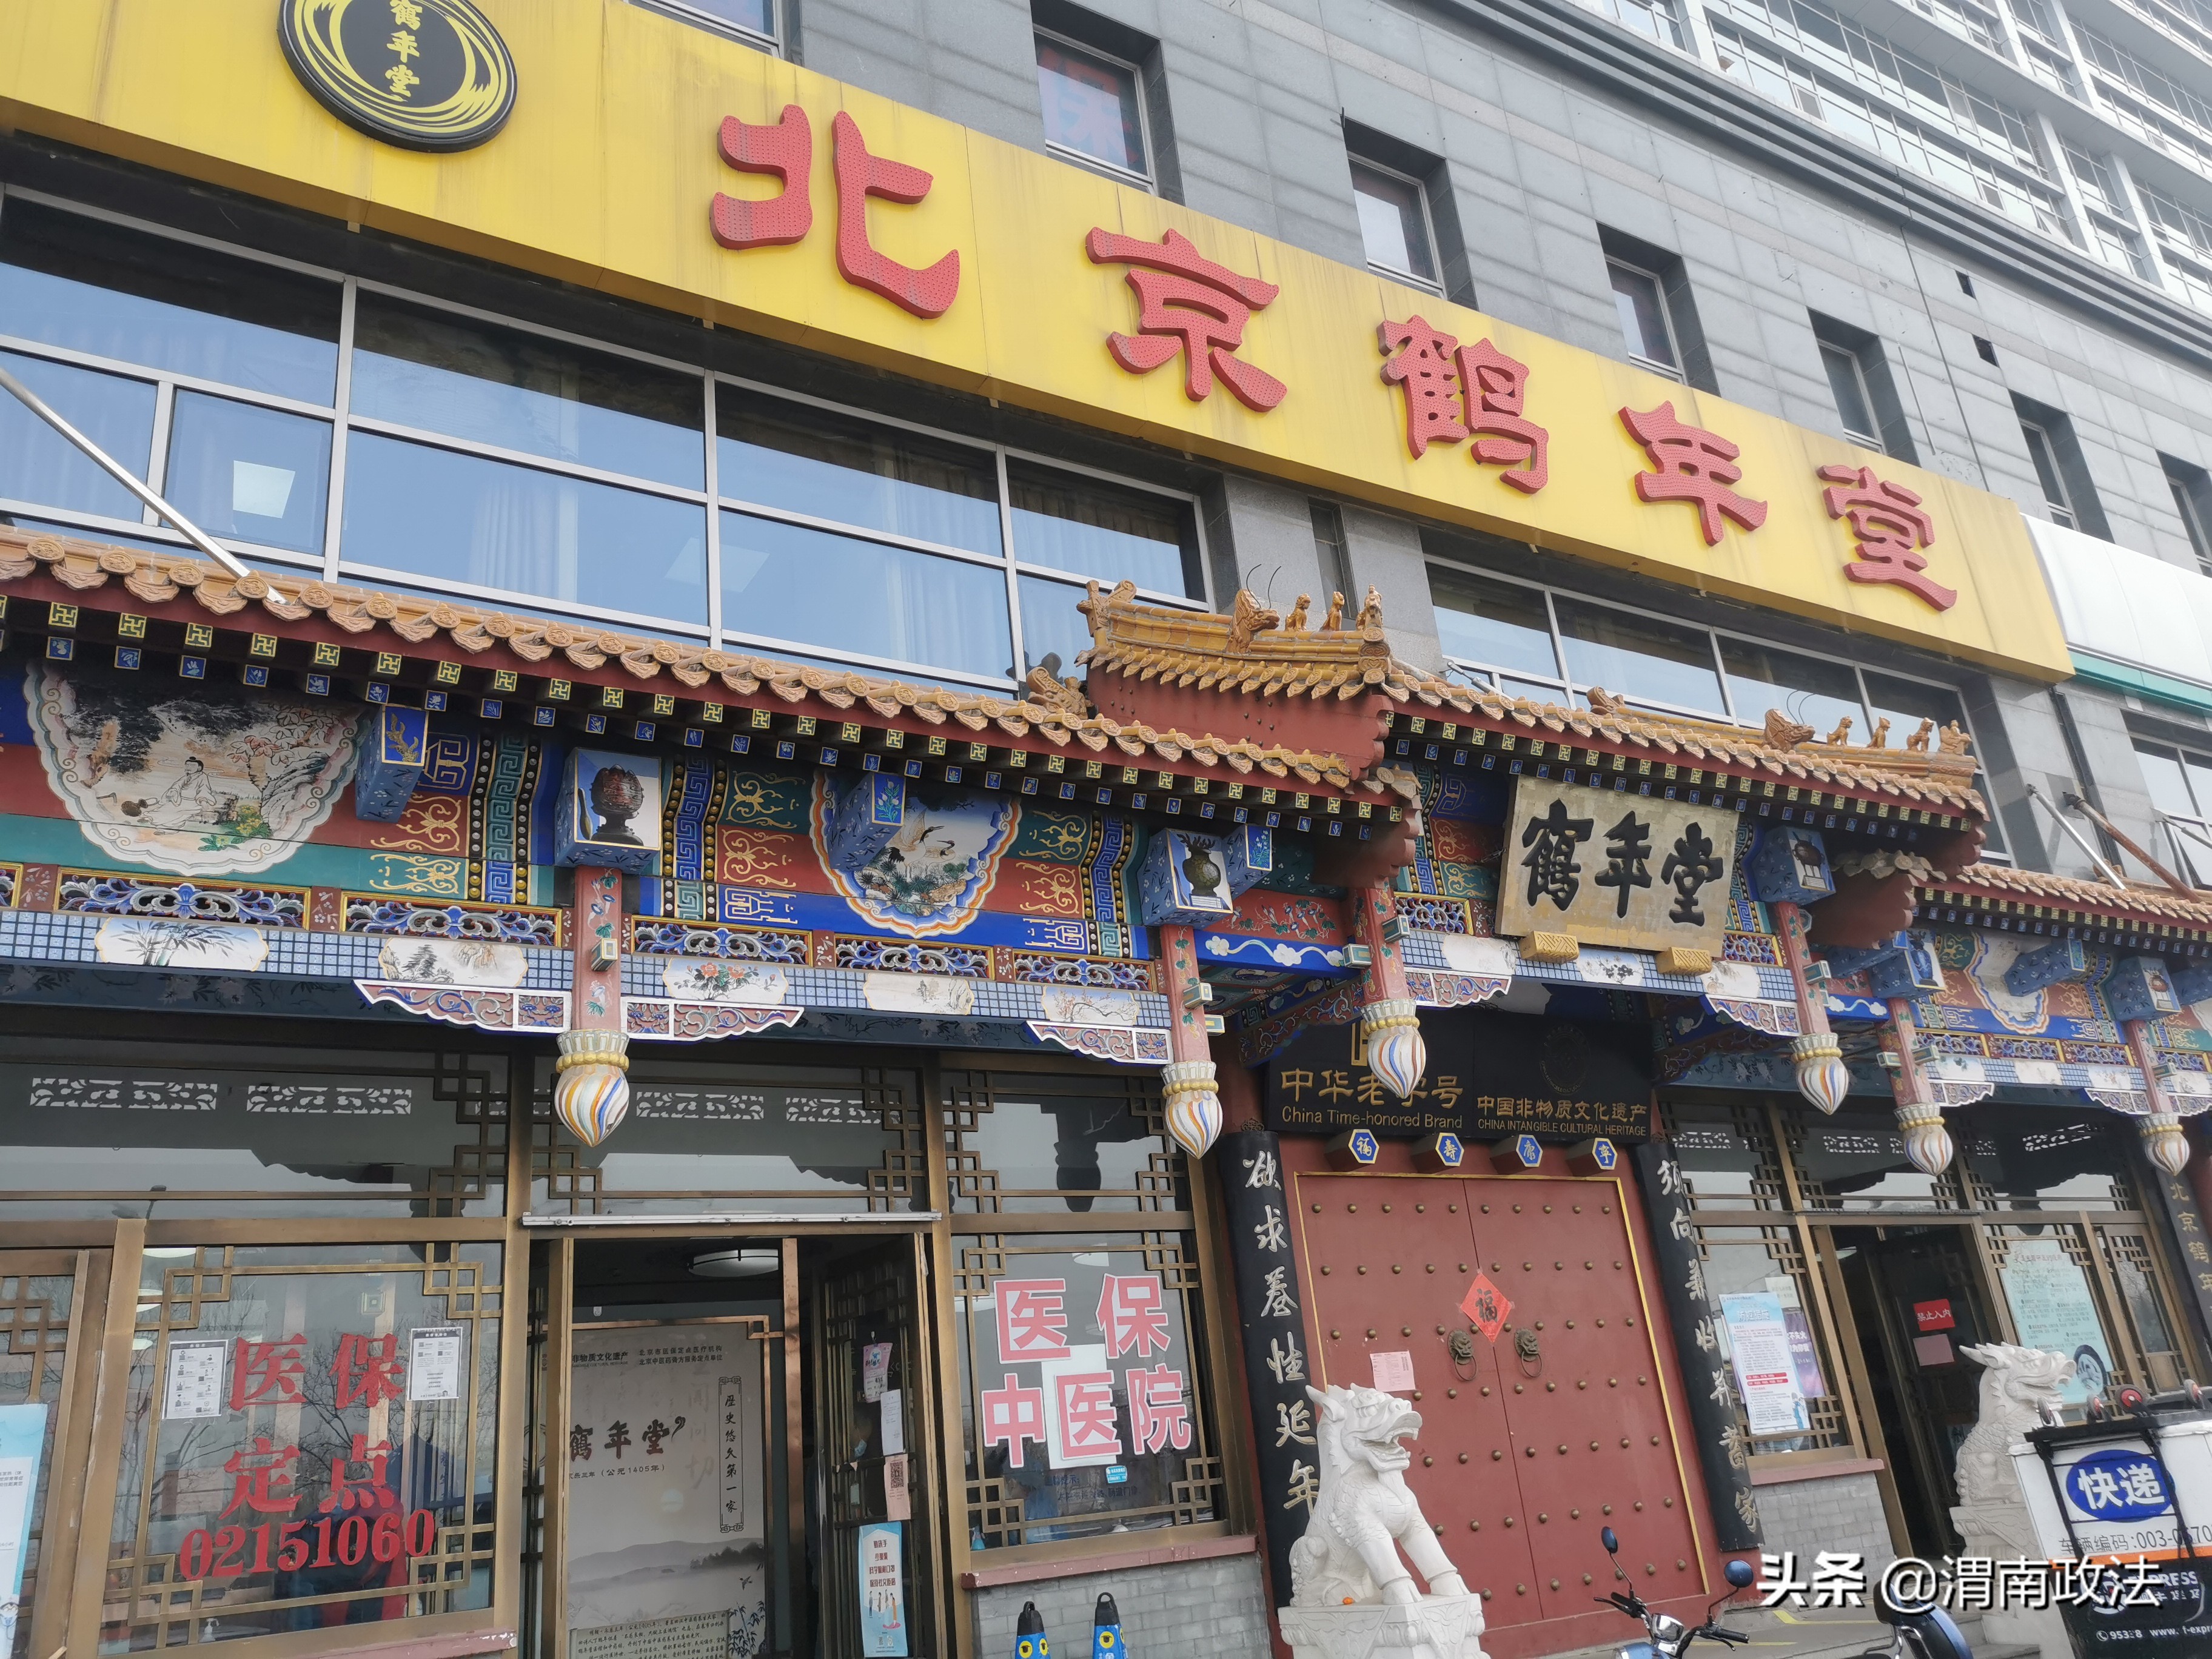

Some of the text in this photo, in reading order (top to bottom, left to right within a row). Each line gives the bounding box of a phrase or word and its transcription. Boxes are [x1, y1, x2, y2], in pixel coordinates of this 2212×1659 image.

[709, 103, 1957, 613] 北京鹤年堂
[1281, 1105, 1463, 1128] China Time-honored Brand
[1476, 1095, 1648, 1124] 中国非物质文化遗产
[1478, 1119, 1646, 1136] CHINA INTANGIBLE CULTURAL HERITAGE
[2168, 1182, 2212, 1313] 北京鹤年
[993, 1273, 1171, 1364] 医保
[1472, 1287, 1499, 1324] 福
[1916, 1308, 1952, 1322] 禁止入内
[229, 1332, 404, 1412] 医保
[981, 1364, 1191, 1469] 中医院
[218, 1433, 395, 1520] 定点
[2077, 1462, 2166, 1510] 快递
[179, 1509, 437, 1582] 02151060
